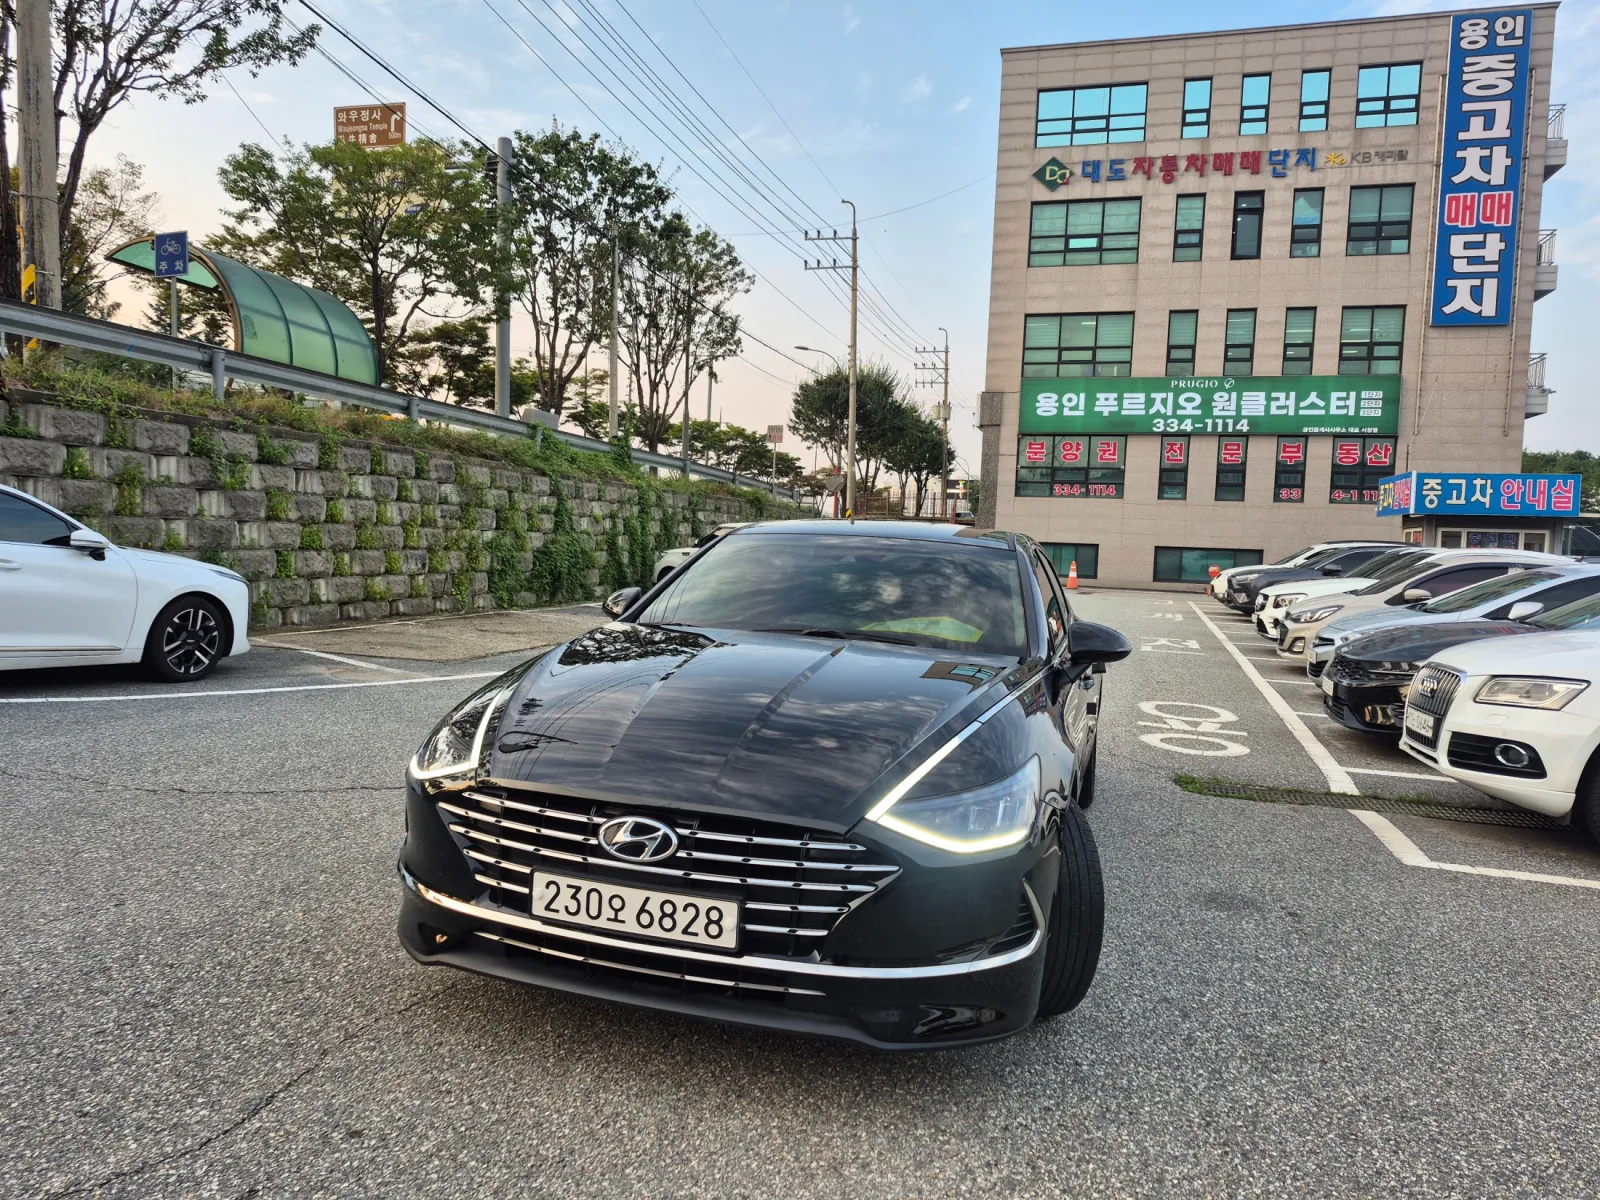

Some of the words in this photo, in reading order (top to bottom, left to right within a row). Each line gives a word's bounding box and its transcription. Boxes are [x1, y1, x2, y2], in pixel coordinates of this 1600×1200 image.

[1459, 15, 1525, 50] 용인
[338, 109, 381, 122] 와우정사
[338, 125, 368, 133] Waujeongsa
[369, 122, 388, 132] Temple
[1450, 53, 1517, 186] 중고차
[1444, 190, 1514, 228] 매매
[159, 260, 184, 273] 주차
[1440, 232, 1506, 318] 단지
[1170, 379, 1219, 389] PRUGIO
[1035, 392, 1086, 416] 용인
[1093, 391, 1202, 417] 푸르지오
[1211, 391, 1356, 416] 원클러스터
[1152, 418, 1250, 432] 334-1114
[1422, 478, 1493, 509] 중고차
[1500, 479, 1575, 511] 안내실
